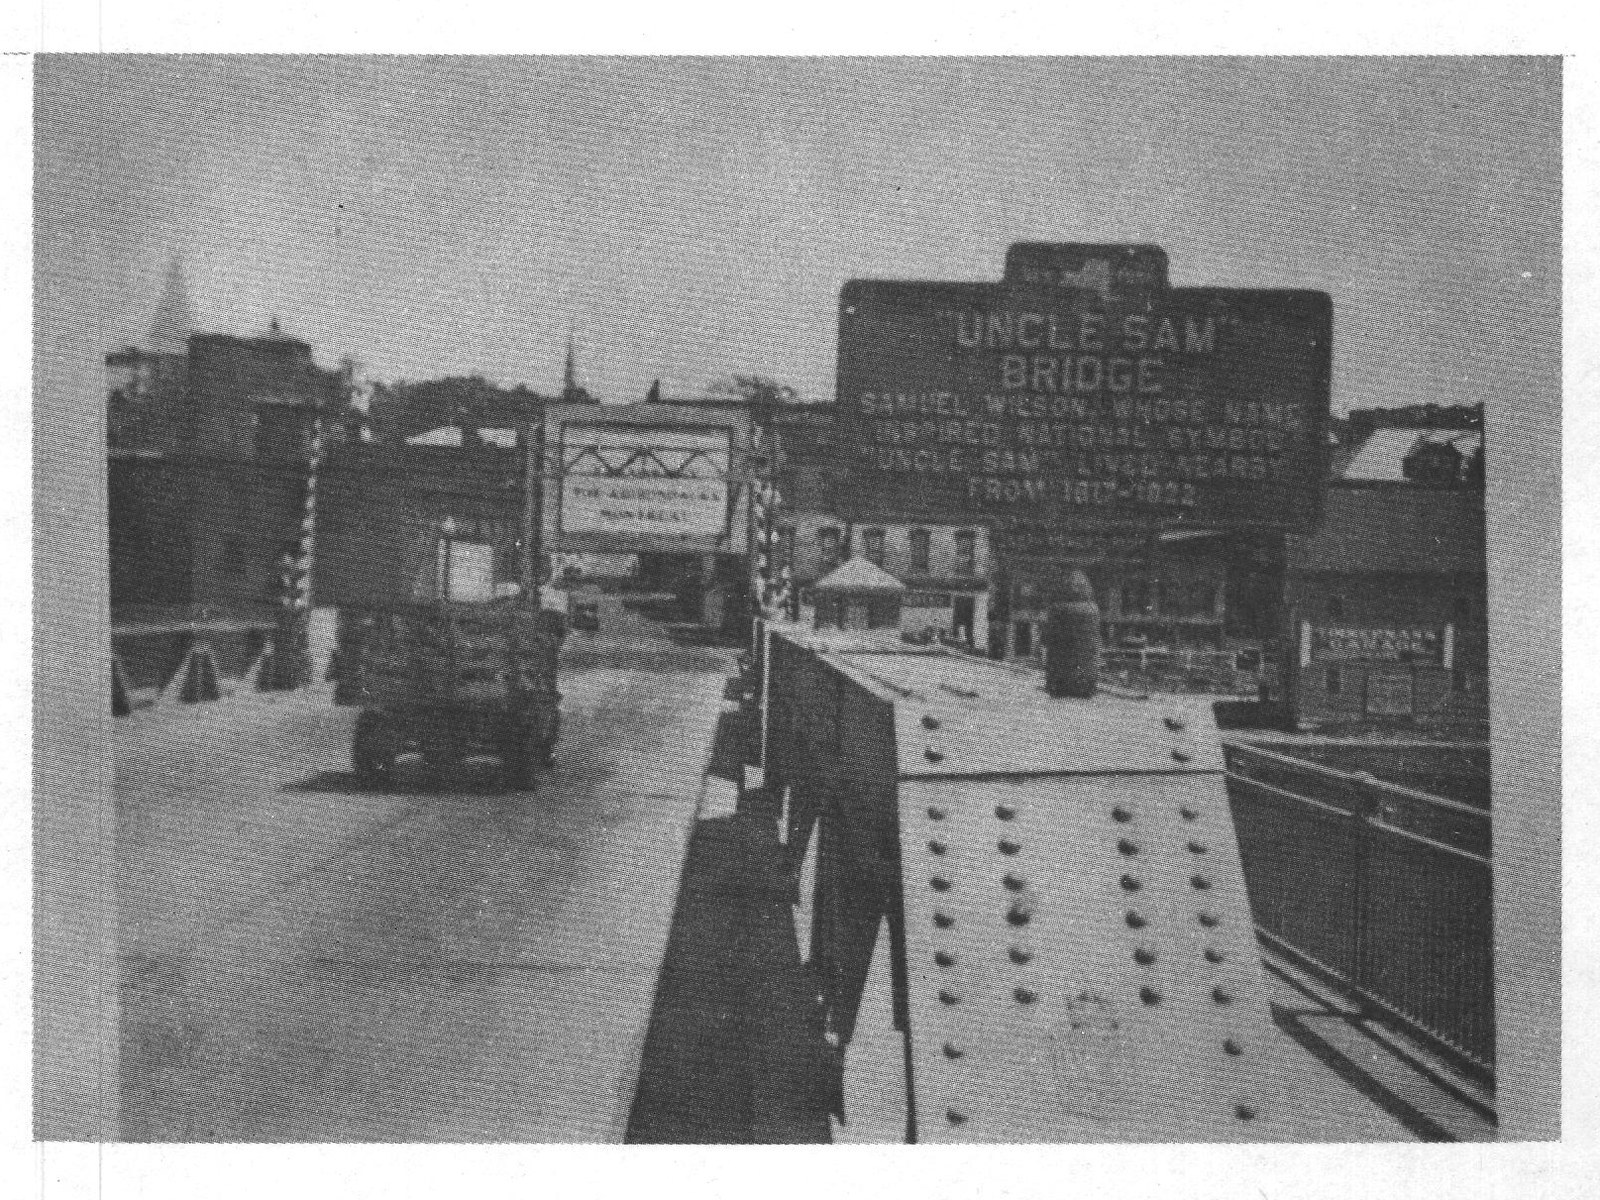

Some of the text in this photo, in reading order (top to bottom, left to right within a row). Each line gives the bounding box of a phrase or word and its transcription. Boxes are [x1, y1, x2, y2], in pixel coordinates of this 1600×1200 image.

[936, 310, 1239, 353] "UNCLE SAM"
[1001, 354, 1164, 393] BRIDGE
[860, 391, 968, 417] SAMUEL
[1112, 397, 1206, 423] WHOSE
[1225, 401, 1302, 427] NAME
[875, 420, 1285, 451] INSPIRED NATIONAL SYMBOL
[860, 445, 1284, 480] "UNCLE SAM" LIVED NEARBY
[967, 476, 1046, 502] FROM
